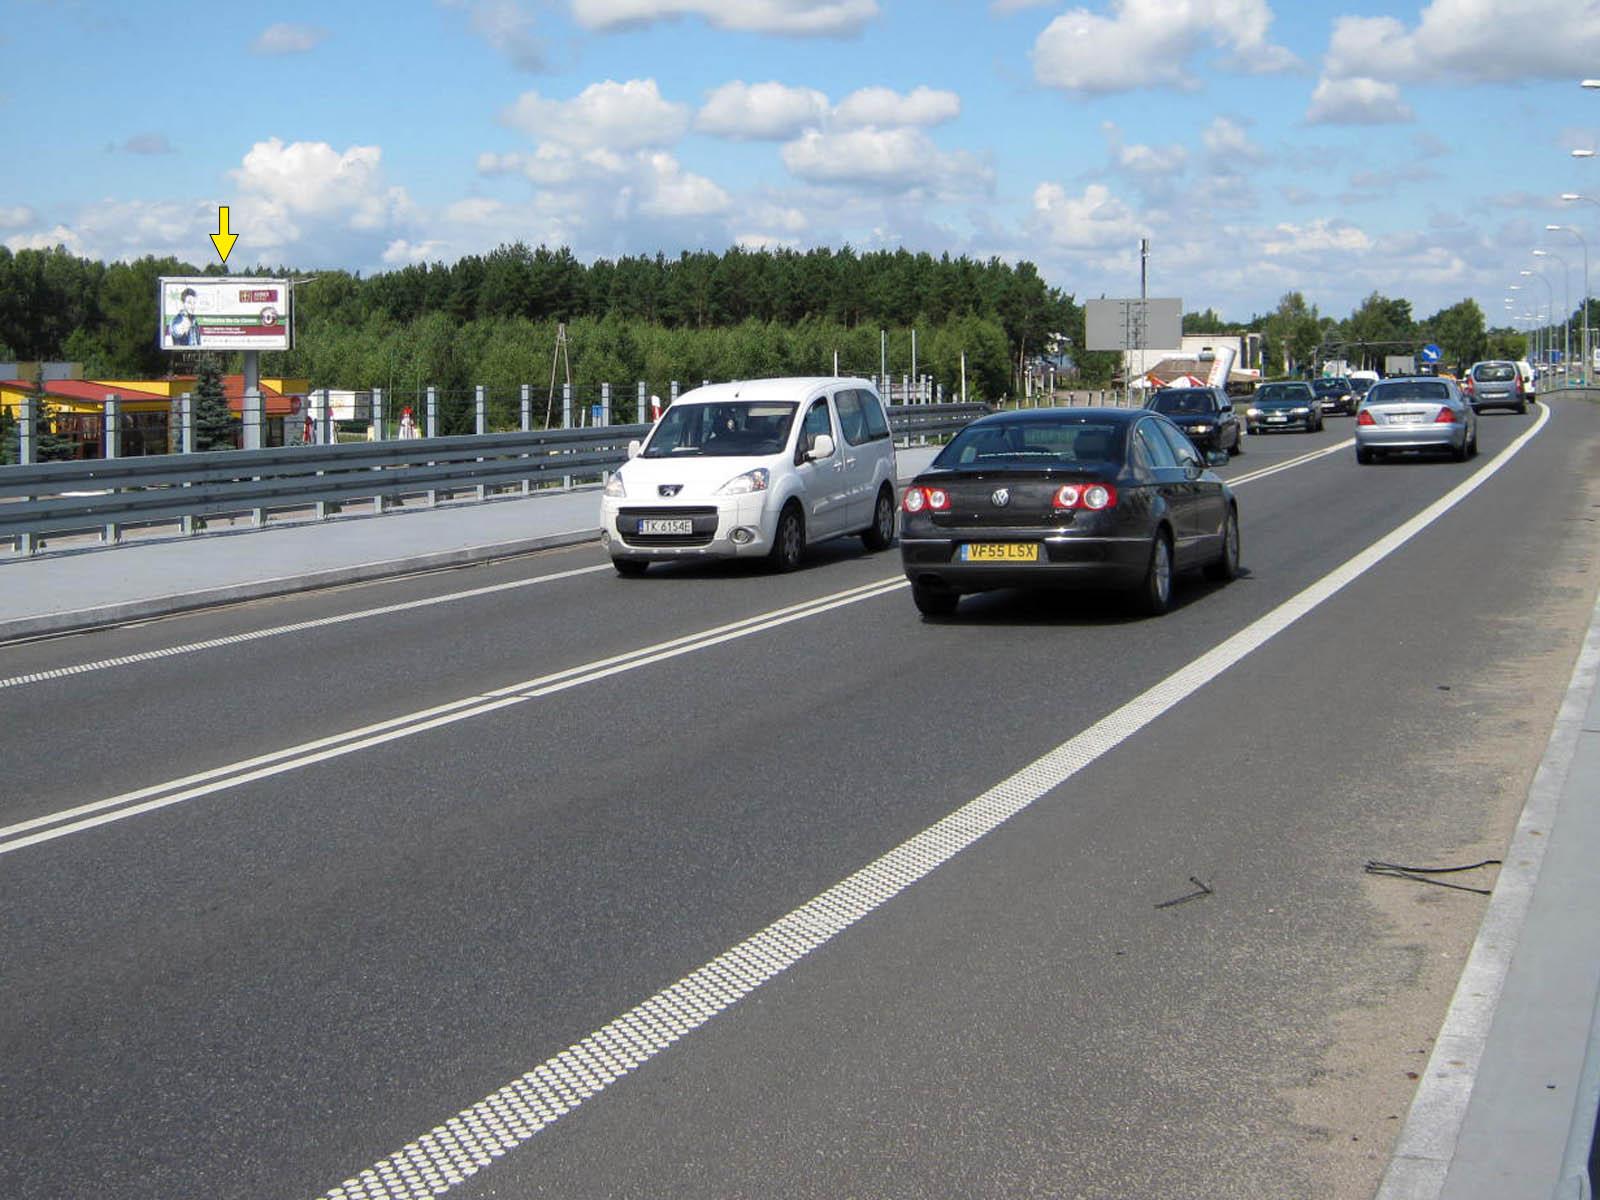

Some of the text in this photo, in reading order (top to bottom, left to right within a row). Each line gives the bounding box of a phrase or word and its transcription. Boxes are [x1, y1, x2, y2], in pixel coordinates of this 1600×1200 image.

[645, 520, 658, 531] TK
[970, 543, 1035, 558] VF55 LSX
